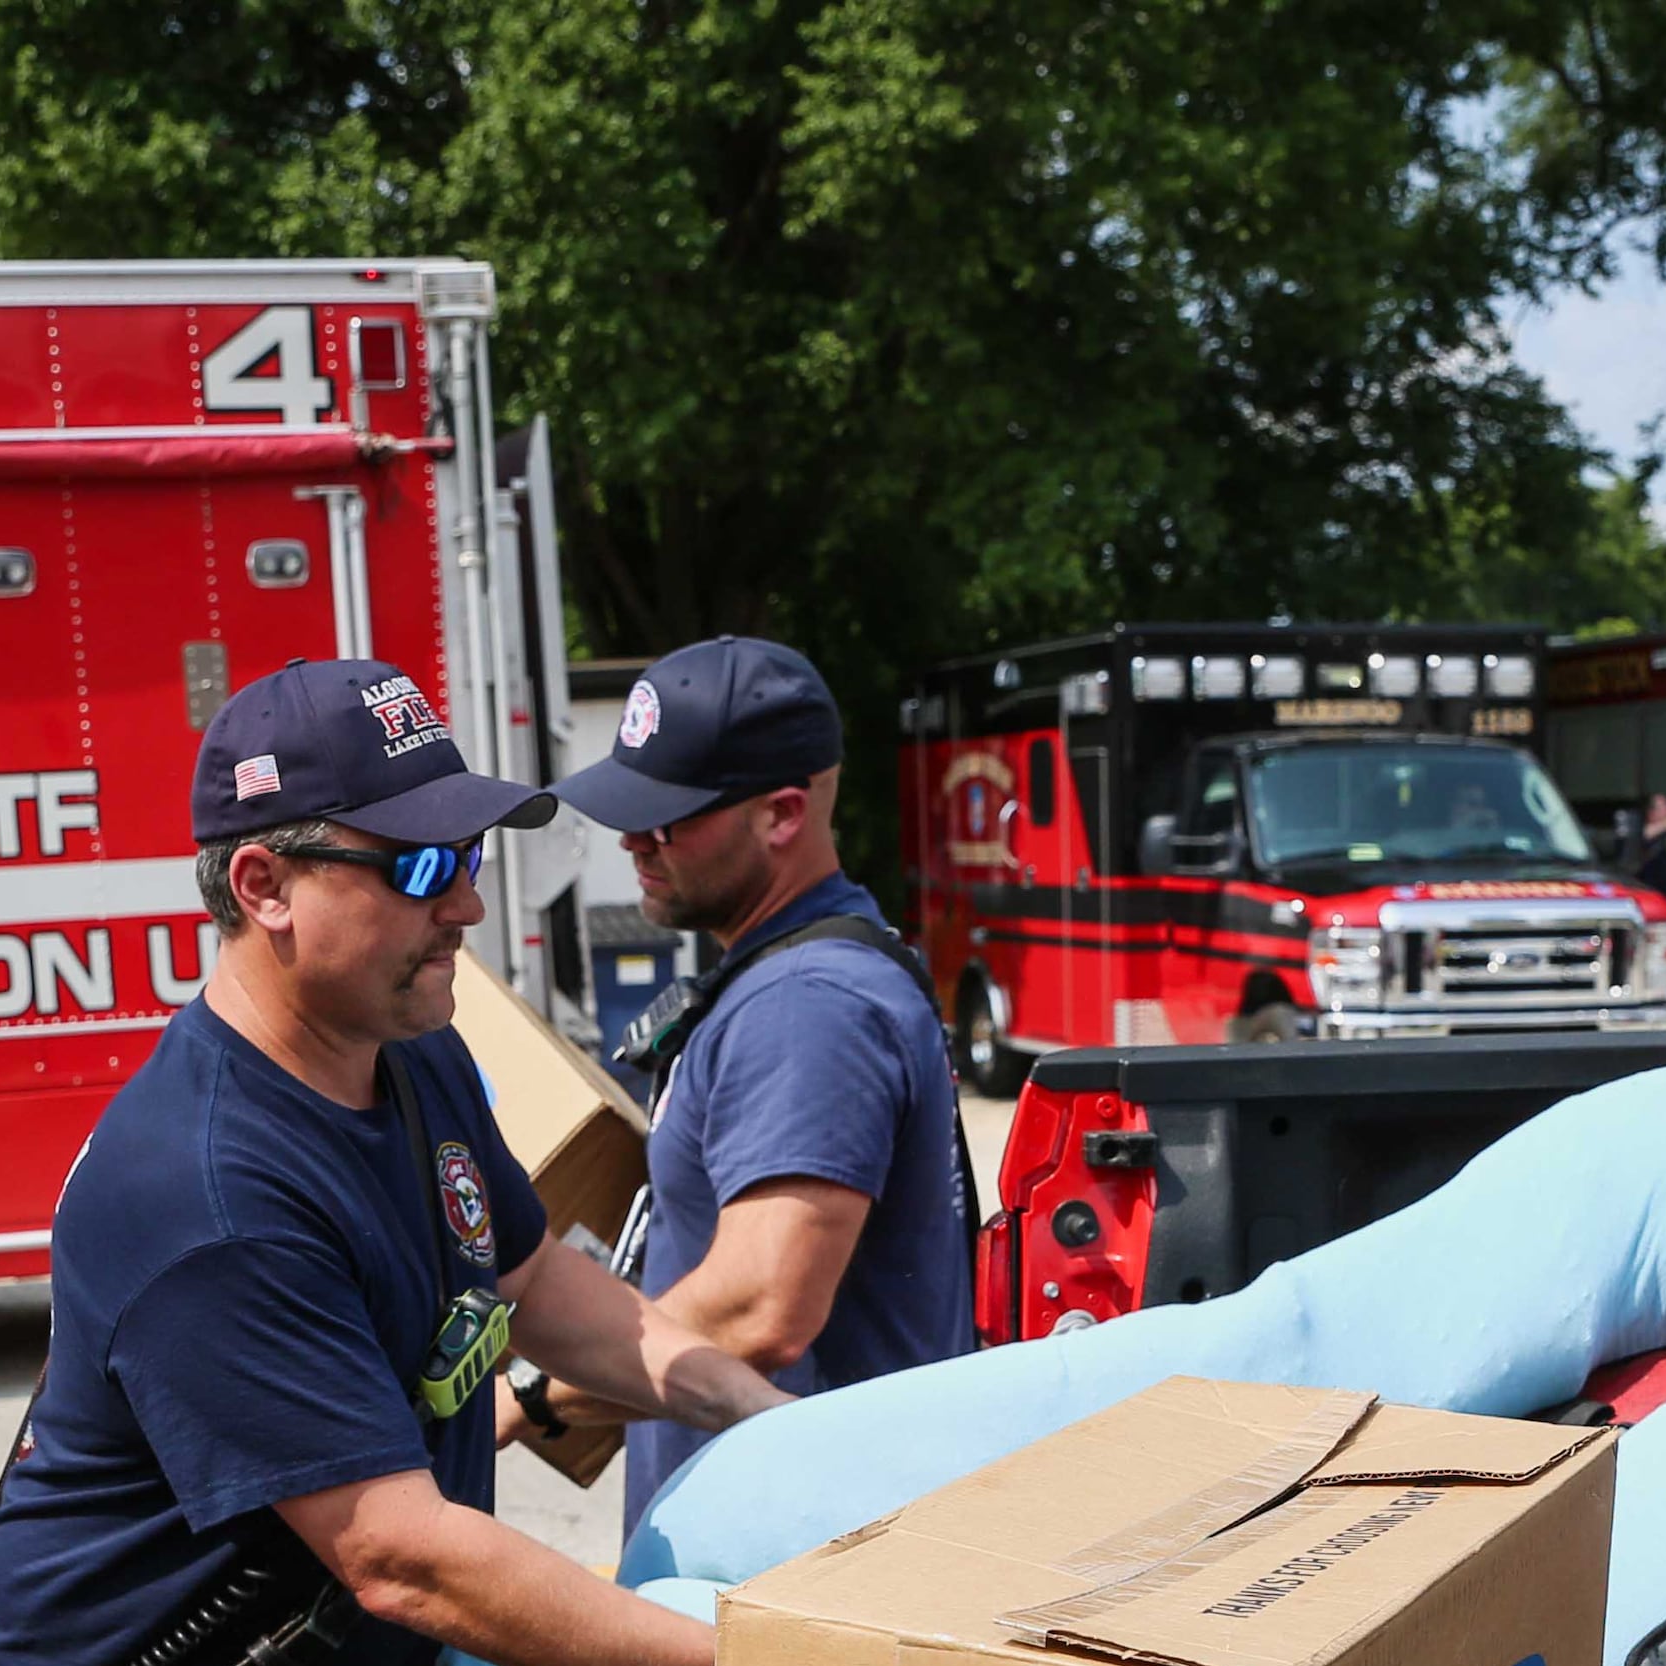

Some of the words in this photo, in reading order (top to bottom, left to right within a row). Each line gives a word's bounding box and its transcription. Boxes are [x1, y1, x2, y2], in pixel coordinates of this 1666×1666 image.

[202, 303, 336, 425] 4
[383, 734, 422, 758] LAKE
[1200, 1577, 1305, 1619] THANKS
[1270, 1557, 1338, 1577] FOR
[1305, 1513, 1413, 1556] CHOOSING
[1379, 1490, 1446, 1512] NEW
